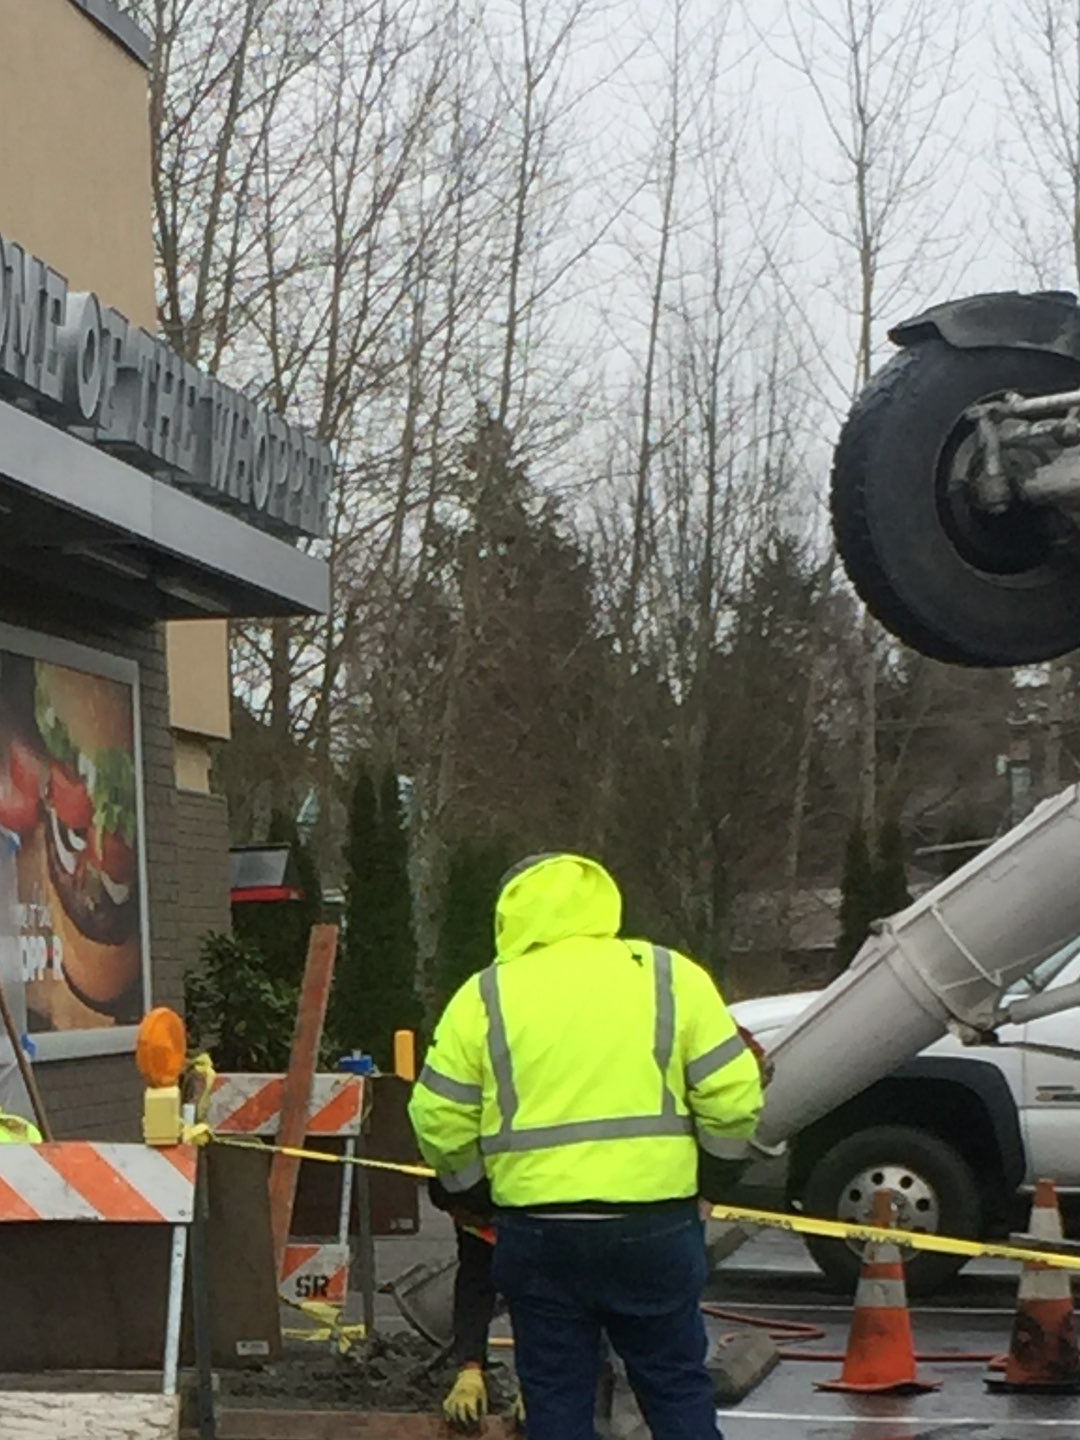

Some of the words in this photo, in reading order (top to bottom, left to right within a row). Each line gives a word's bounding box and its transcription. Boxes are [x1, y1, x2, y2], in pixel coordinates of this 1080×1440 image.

[73, 292, 129, 430] OF
[135, 326, 201, 476] THE
[295, 1275, 329, 1299] SR
